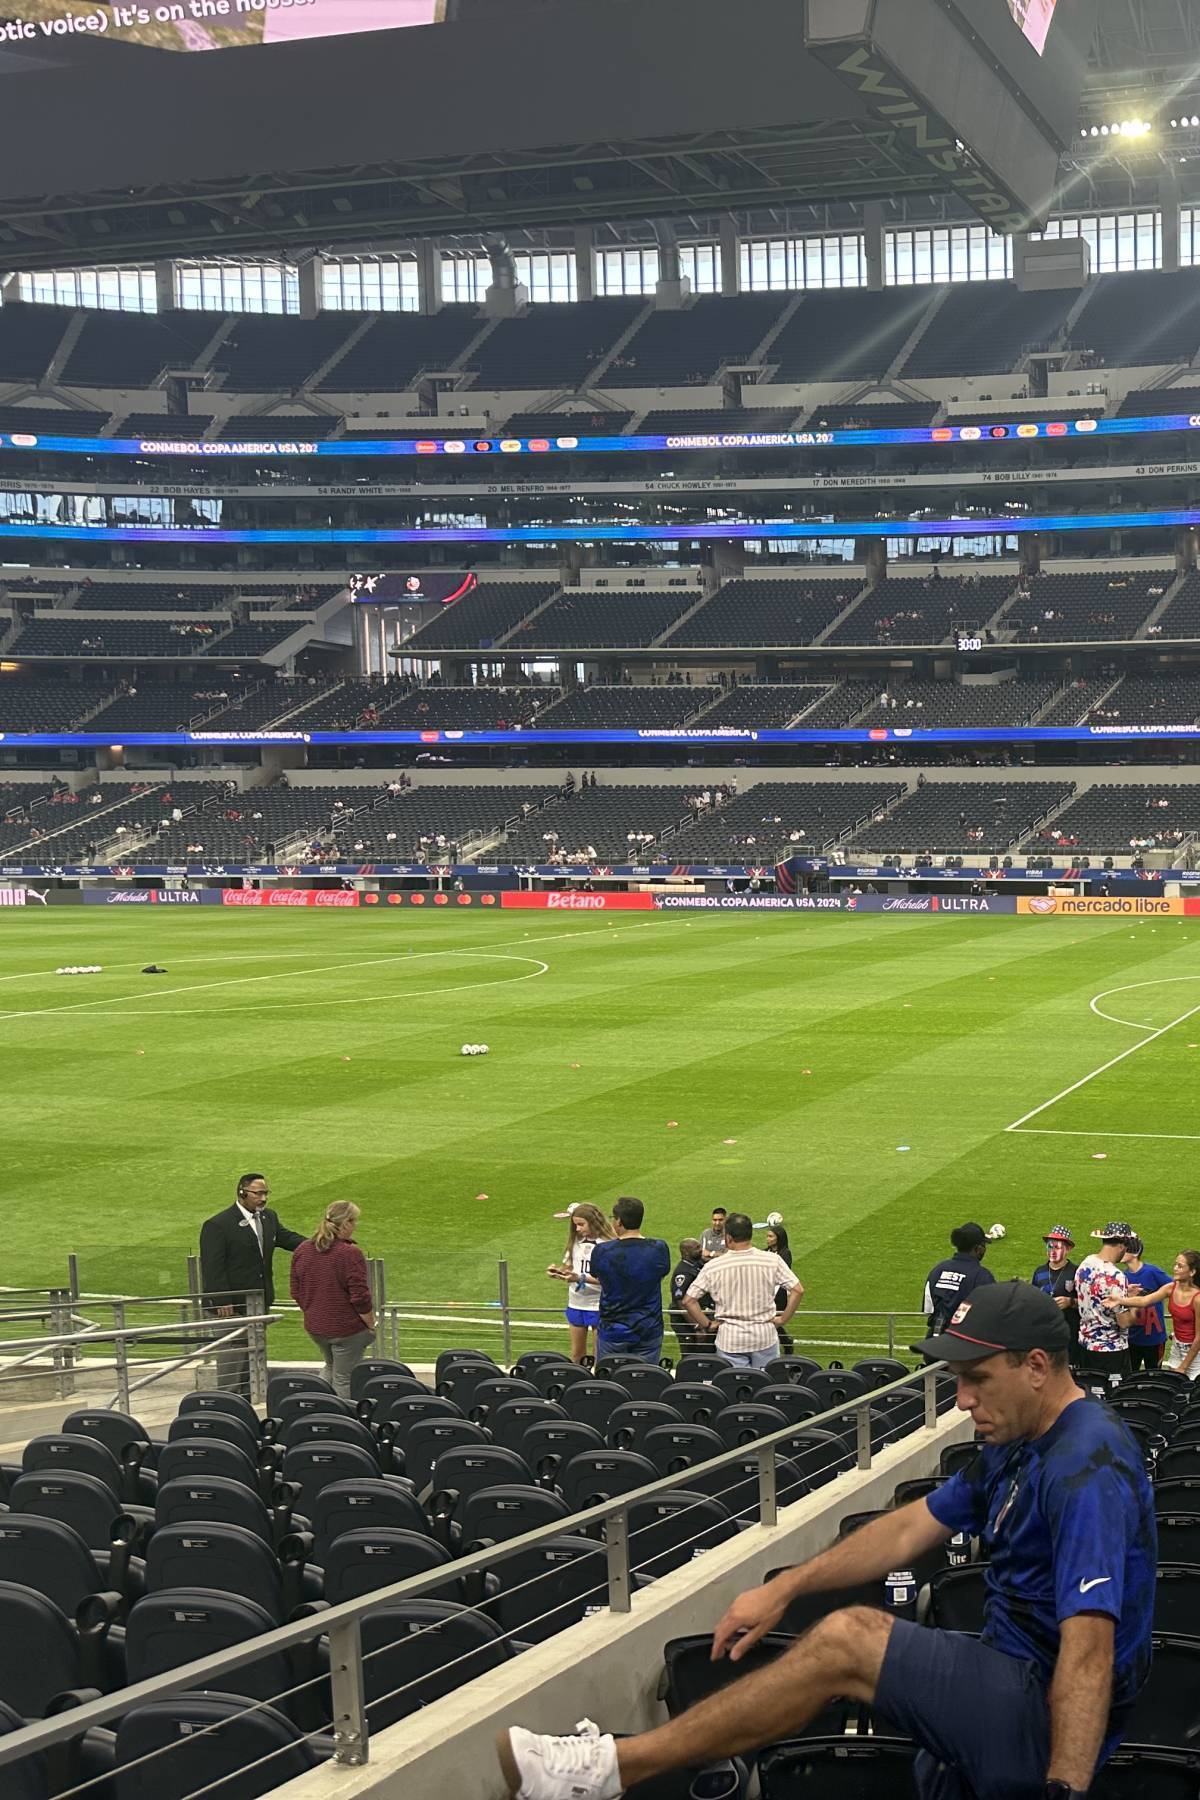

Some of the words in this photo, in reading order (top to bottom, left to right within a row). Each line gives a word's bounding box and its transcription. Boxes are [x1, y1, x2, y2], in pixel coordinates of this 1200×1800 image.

[38, 9, 108, 36] voice)
[113, 4, 151, 28] It's
[157, 5, 186, 22] on
[189, 0, 230, 18] the
[836, 47, 1029, 231] WINSTAR
[666, 436, 722, 448] CONMEBOL
[722, 434, 750, 446] COPA
[749, 433, 795, 446] AMERICA
[795, 432, 815, 444] USA
[140, 440, 202, 453] CONMEBOL
[203, 441, 231, 454] COPA
[230, 442, 278, 454] AMERICA
[279, 442, 299, 454] USA
[982, 473, 992, 481] 74
[994, 472, 1010, 481] BOB
[1011, 471, 1031, 481] LILLY
[1135, 467, 1146, 475] 43
[1148, 466, 1164, 474] DON
[1165, 464, 1198, 473] PERKINS
[657, 482, 681, 490] CHUCK
[681, 481, 712, 489] HOWLEY
[840, 477, 877, 486] MEREDITH
[150, 486, 161, 494] 22
[163, 486, 182, 495] BOB
[182, 487, 211, 495] HAYES
[318, 487, 329, 495] 54
[330, 487, 357, 495] RANDY
[358, 486, 383, 494] WHITE
[487, 485, 498, 493] 20
[500, 485, 516, 493] MEL
[957, 638, 982, 651] 30:00
[106, 890, 149, 903] Michelob
[158, 891, 200, 902] ULTRA
[547, 893, 605, 908] Betano
[664, 896, 721, 908] CONMEBOL
[721, 896, 749, 908] COPA
[749, 897, 794, 908] AMERICA
[796, 898, 816, 908] USA
[816, 898, 841, 908] 2024
[882, 897, 930, 911] Michelob
[941, 899, 989, 911] ULTRA
[1061, 898, 1133, 913] mercado
[1135, 897, 1171, 913] libre
[580, 1259, 591, 1274] 10
[939, 1270, 966, 1284] BEST
[945, 1550, 967, 1567] Lite
